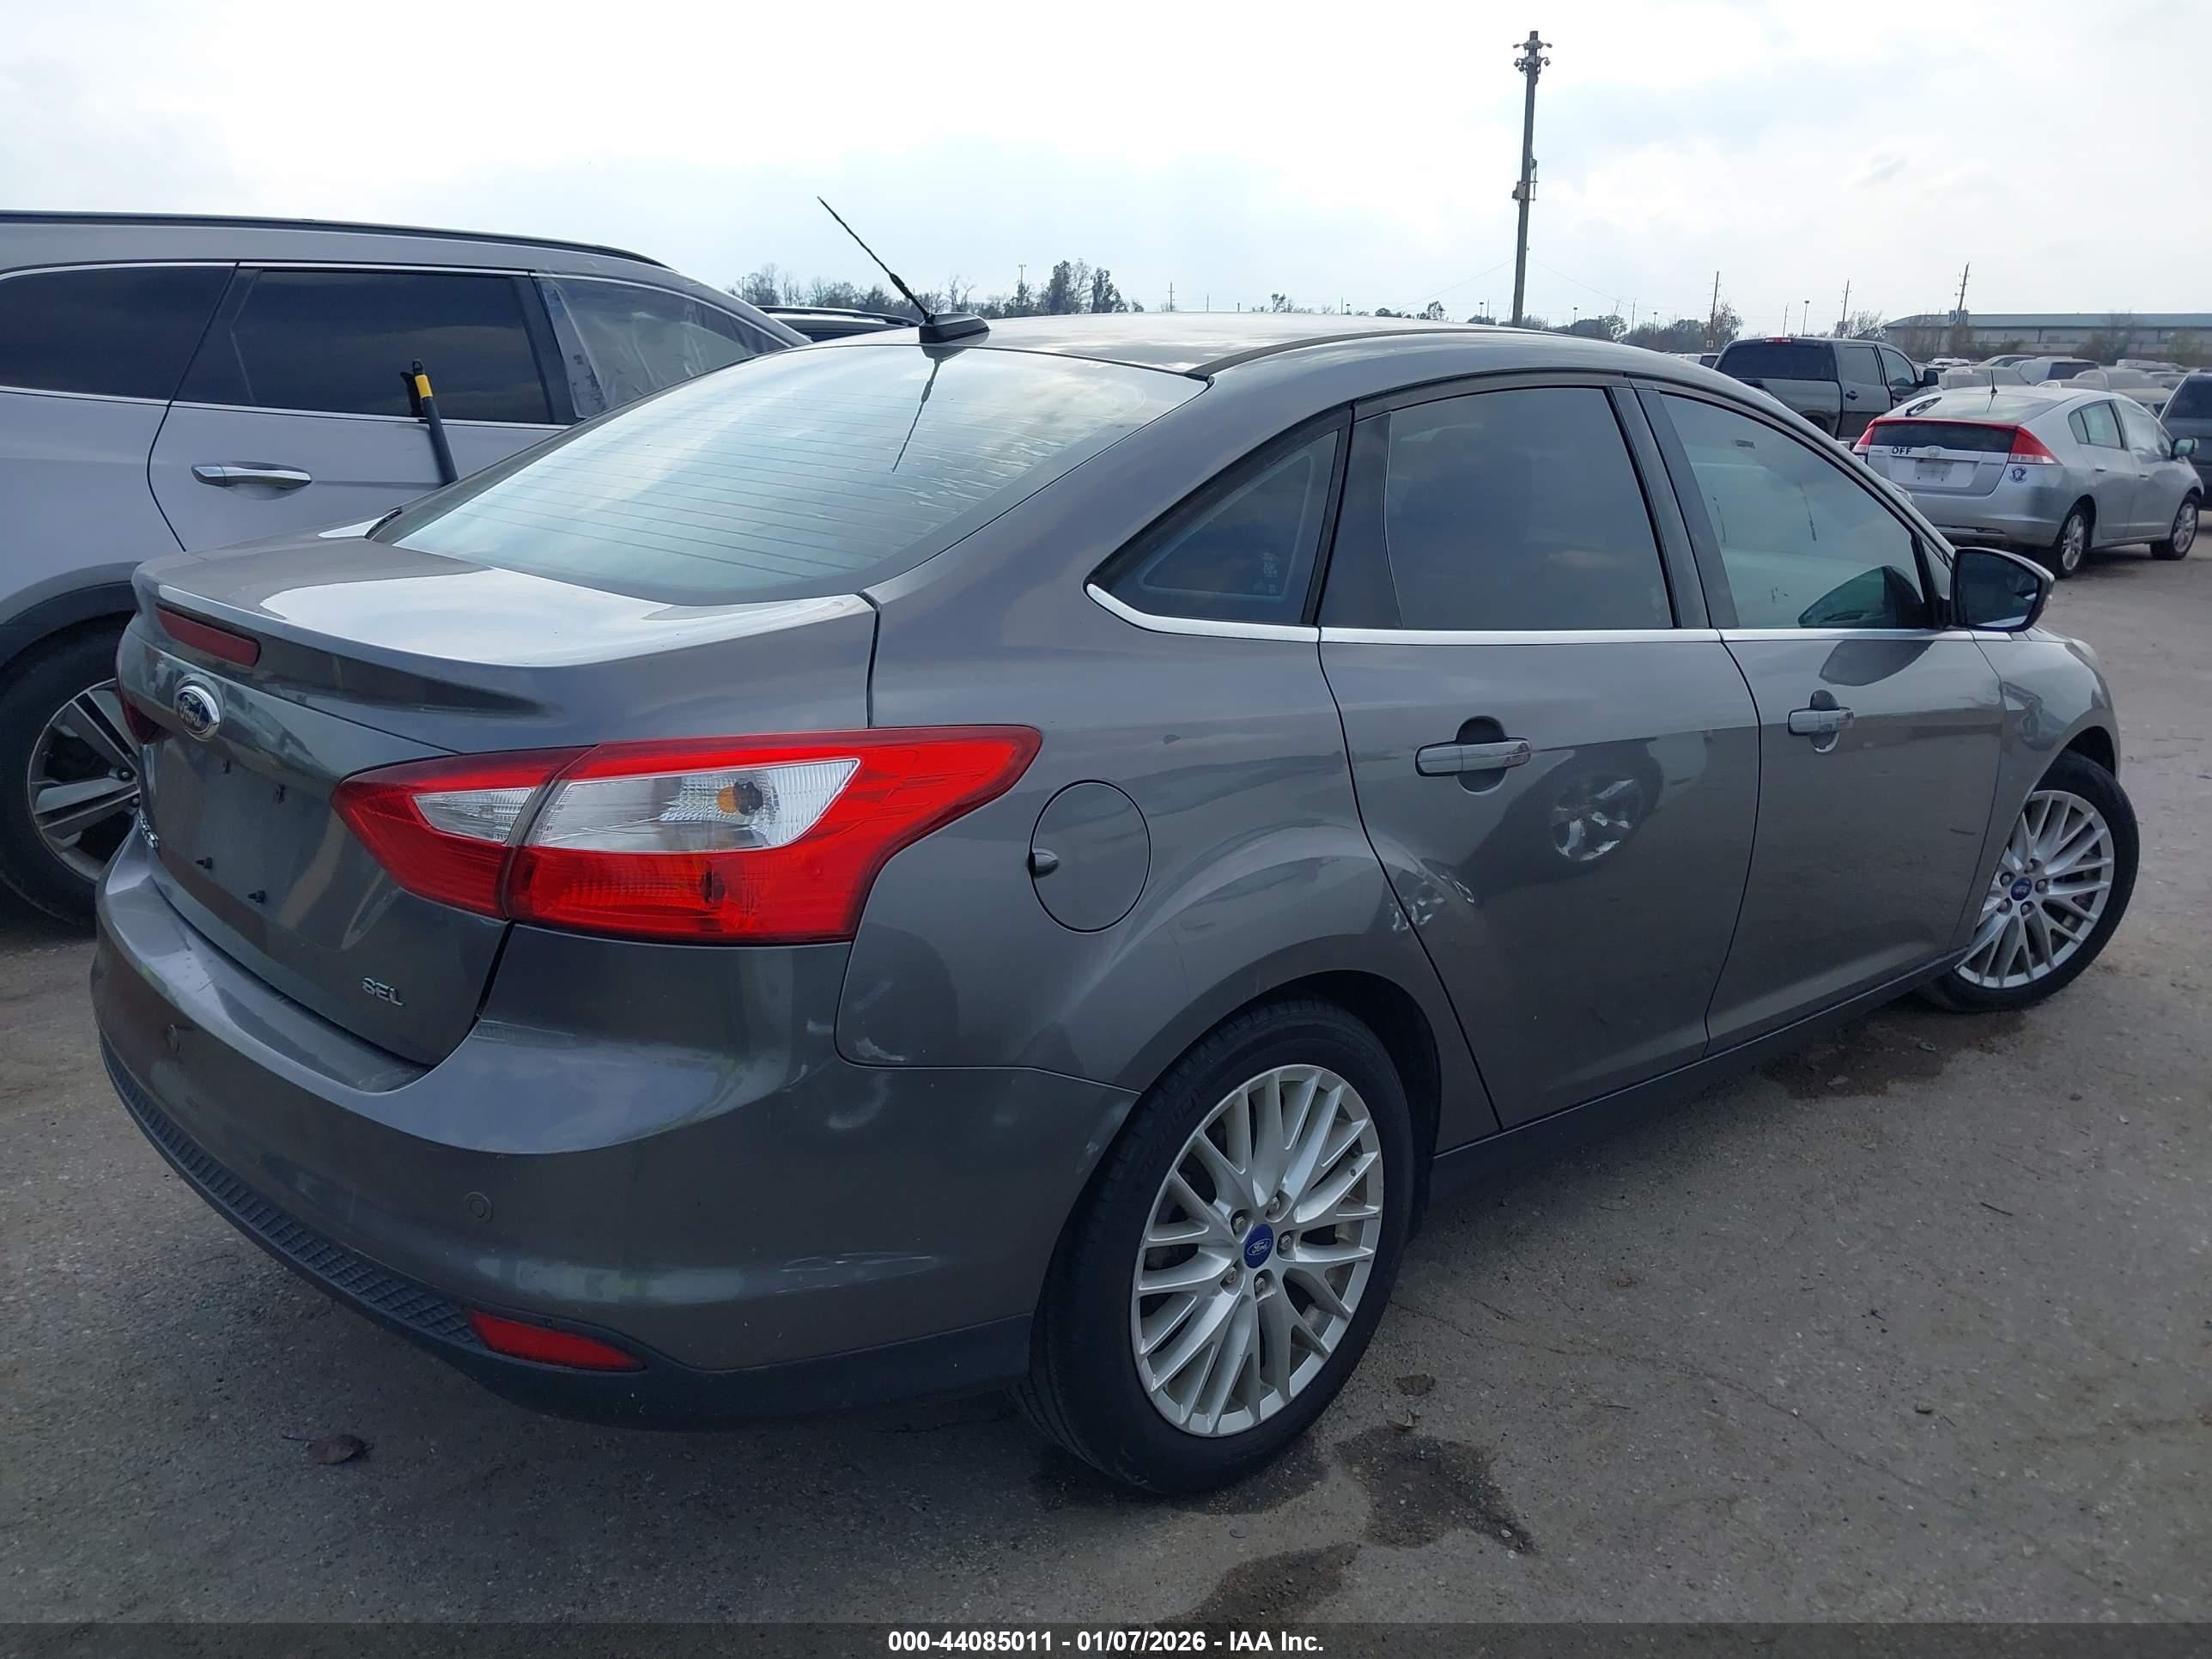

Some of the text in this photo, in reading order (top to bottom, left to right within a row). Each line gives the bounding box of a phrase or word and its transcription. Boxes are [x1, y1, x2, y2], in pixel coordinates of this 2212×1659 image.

[1892, 447, 1912, 455] OFF
[179, 695, 207, 728] Ford
[362, 977, 404, 1006] SEL
